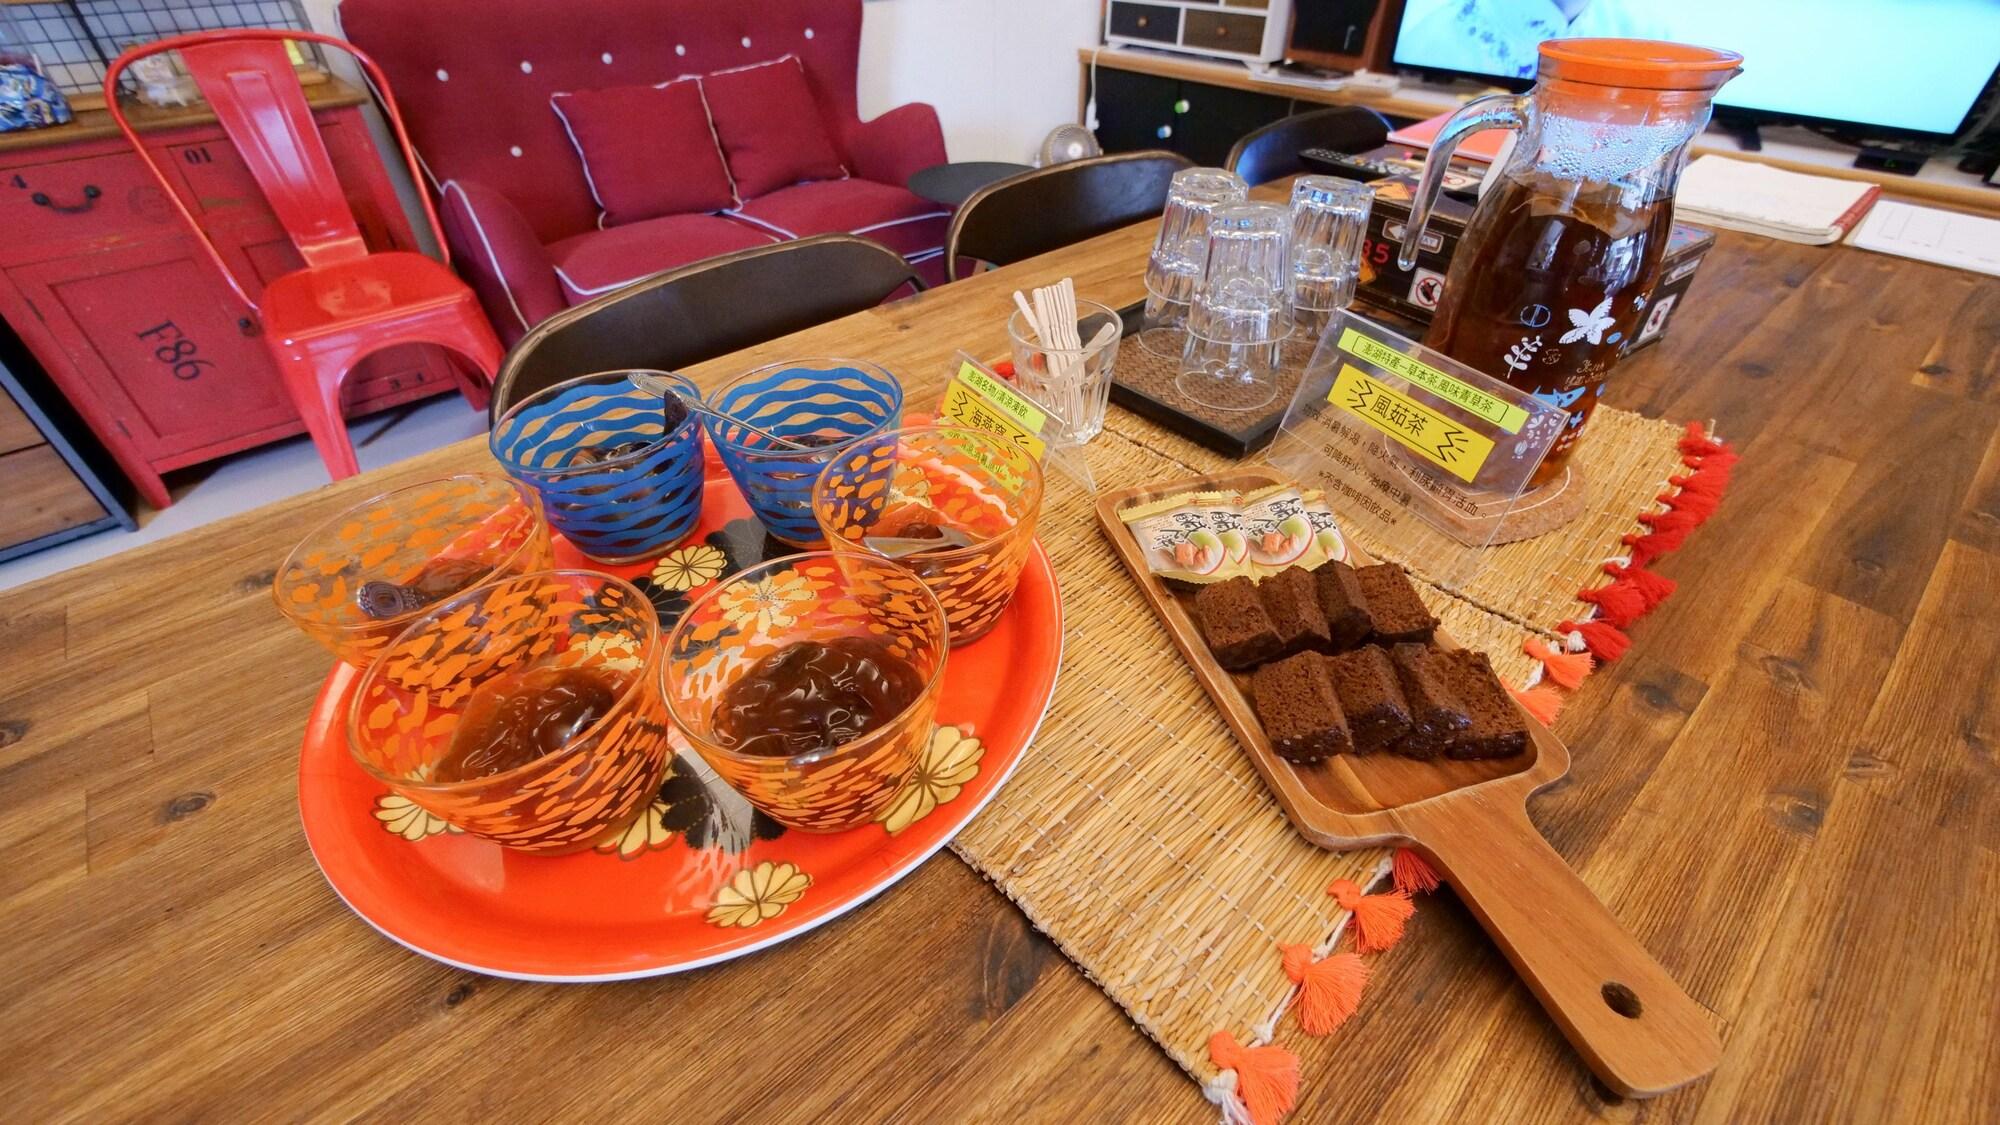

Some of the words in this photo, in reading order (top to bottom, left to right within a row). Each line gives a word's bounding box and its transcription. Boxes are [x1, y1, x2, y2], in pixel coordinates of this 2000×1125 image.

[135, 319, 217, 381] F86
[1369, 394, 1429, 437] 風茹茶
